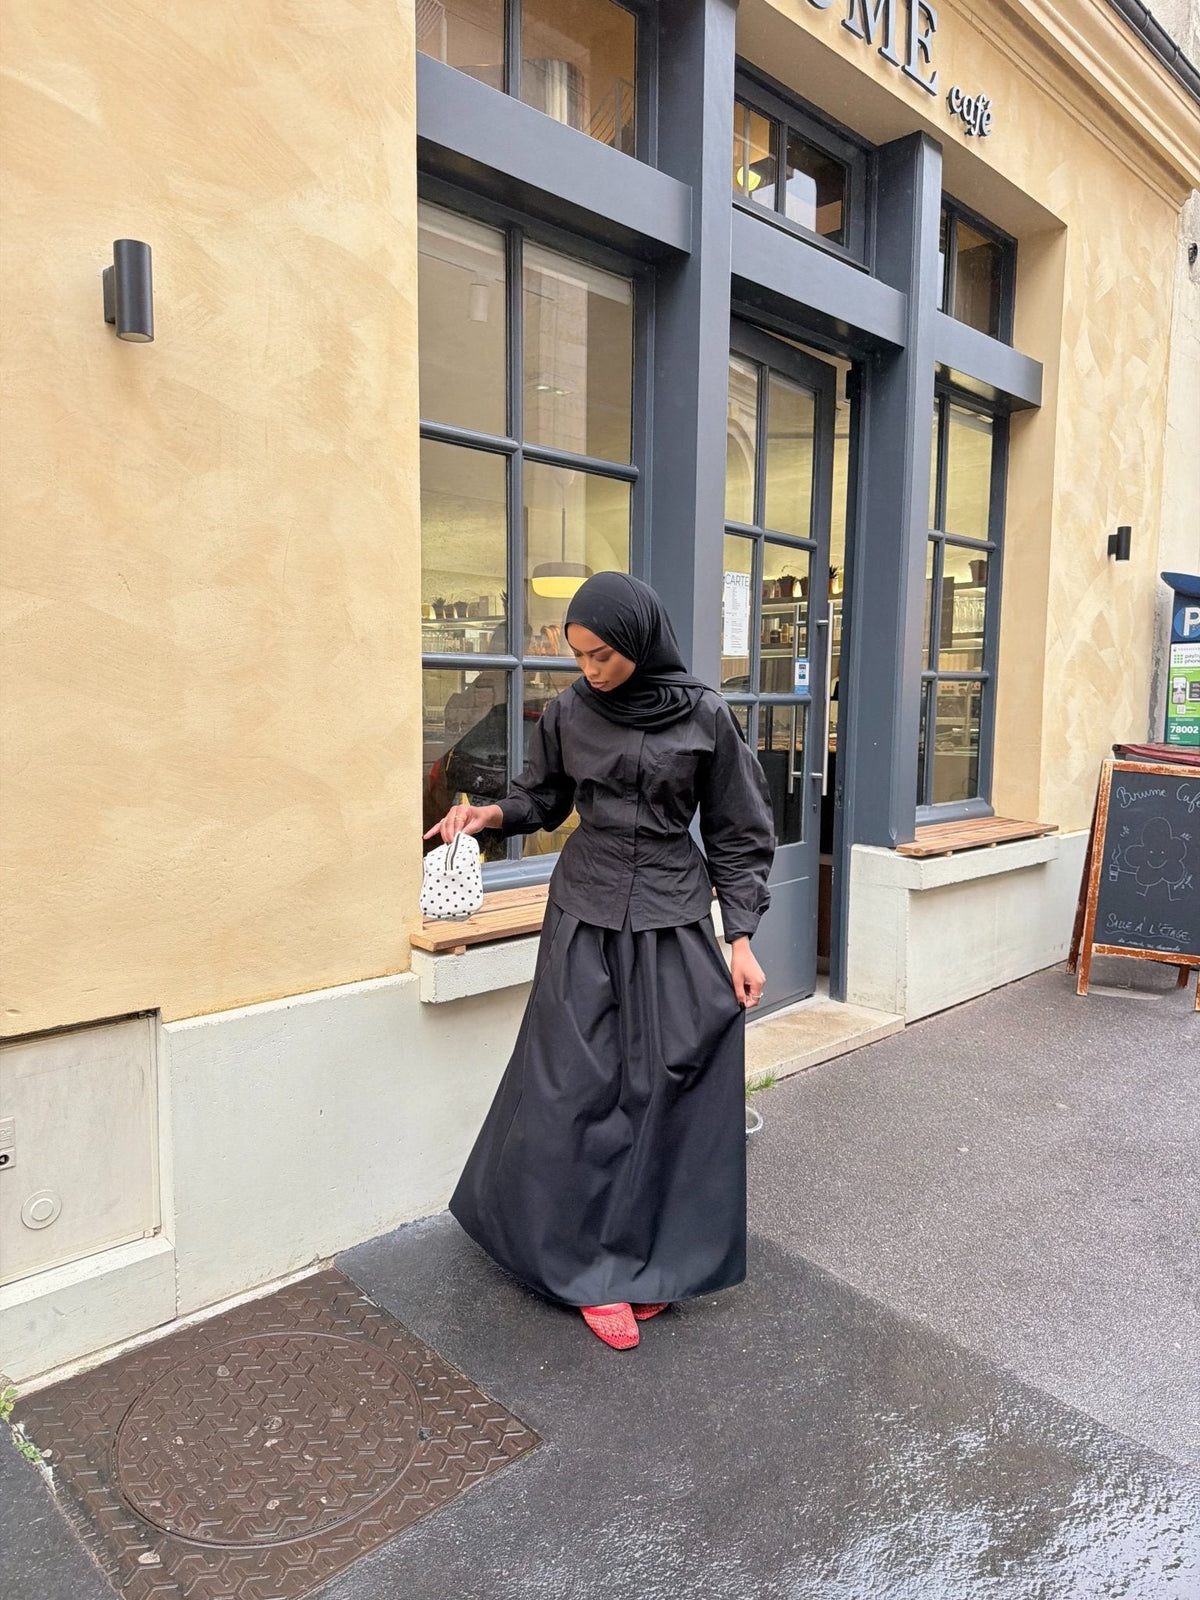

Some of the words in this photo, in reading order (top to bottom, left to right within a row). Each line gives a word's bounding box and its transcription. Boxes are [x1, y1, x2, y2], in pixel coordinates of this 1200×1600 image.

[807, 0, 939, 96] ME
[946, 85, 994, 137] café
[725, 573, 749, 587] CARTE
[1183, 607, 1200, 636] P
[1170, 725, 1199, 734] 78002
[1116, 786, 1167, 809] Brume
[1107, 912, 1132, 929] SALLE
